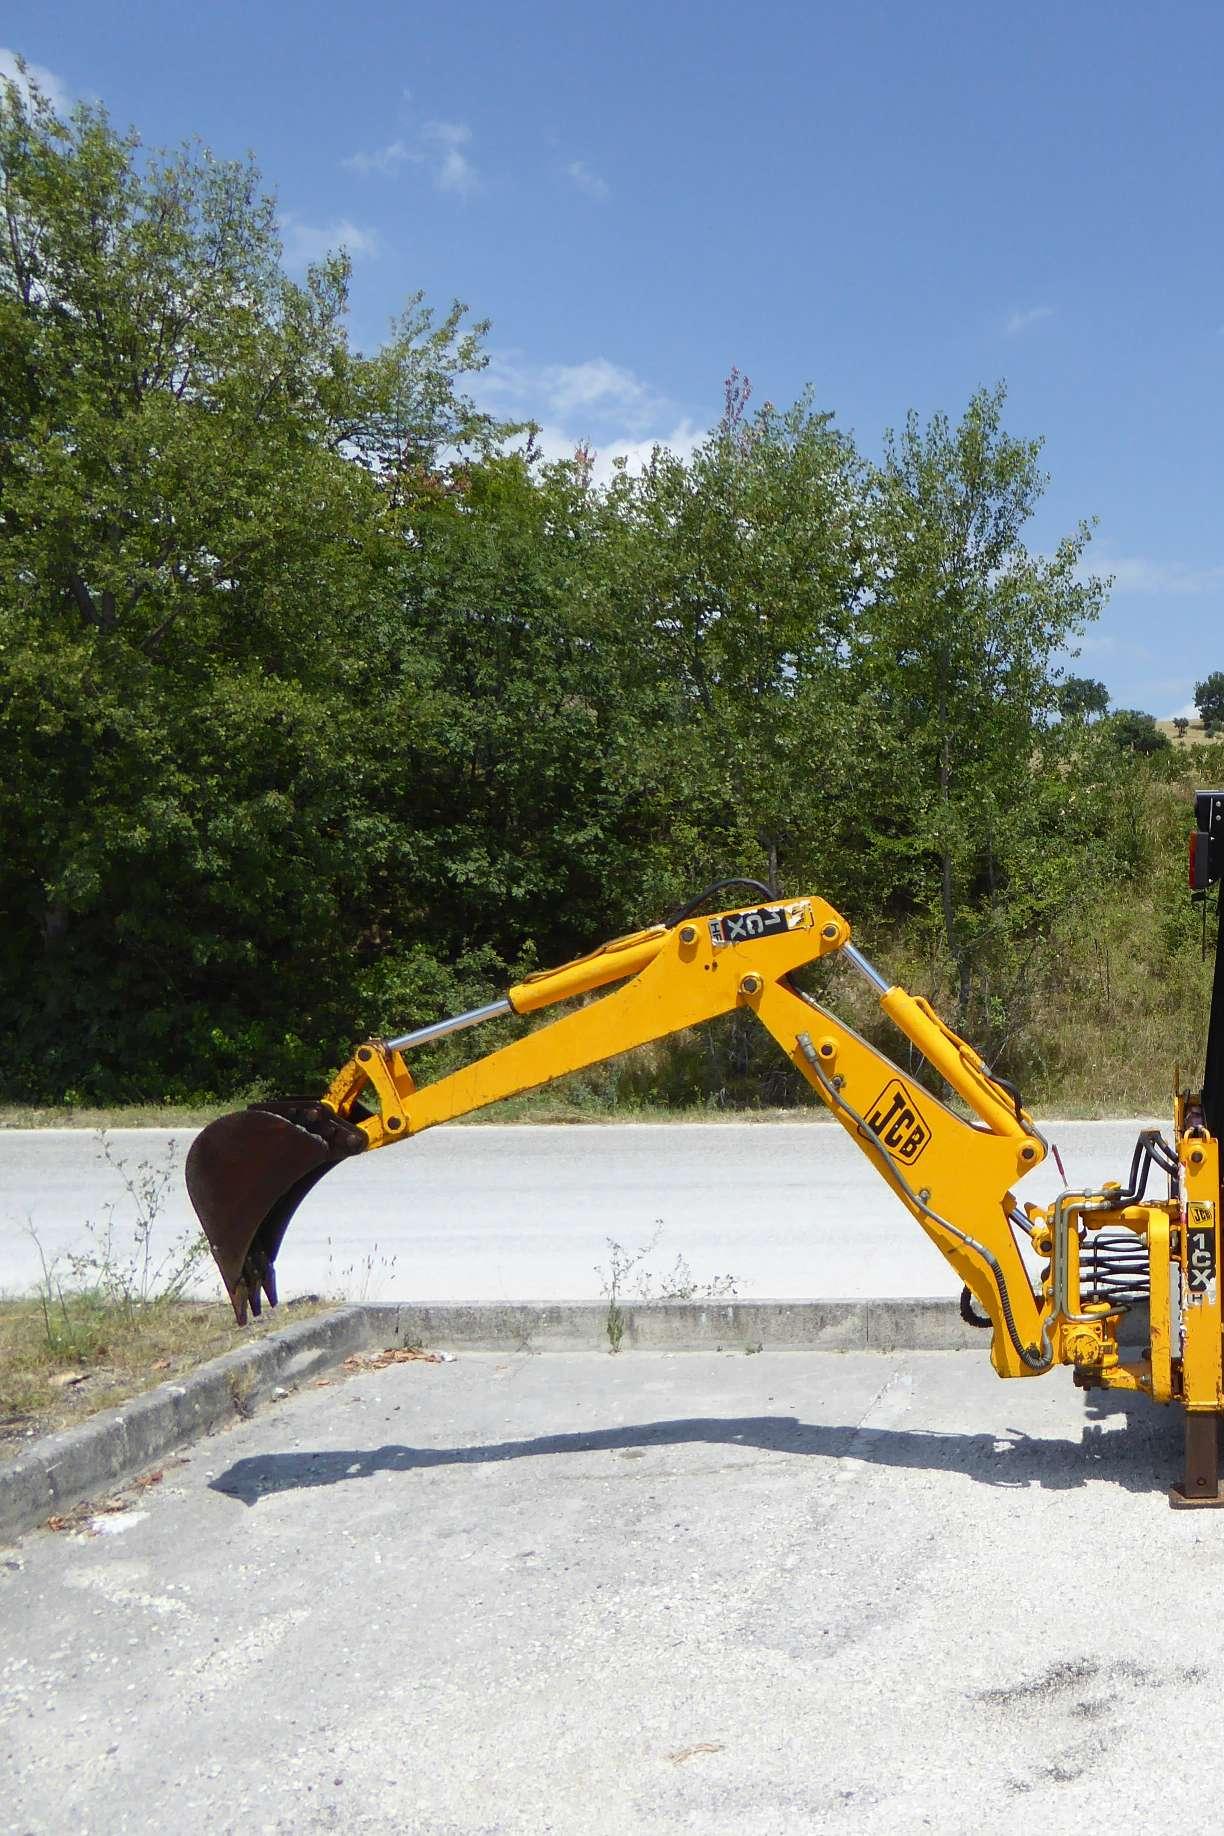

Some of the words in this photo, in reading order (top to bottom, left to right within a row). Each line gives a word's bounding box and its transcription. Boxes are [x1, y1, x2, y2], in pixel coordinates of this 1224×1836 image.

[867, 1091, 925, 1158] JCB
[1193, 1207, 1212, 1222] JCB
[1191, 1233, 1212, 1287] 1CX
